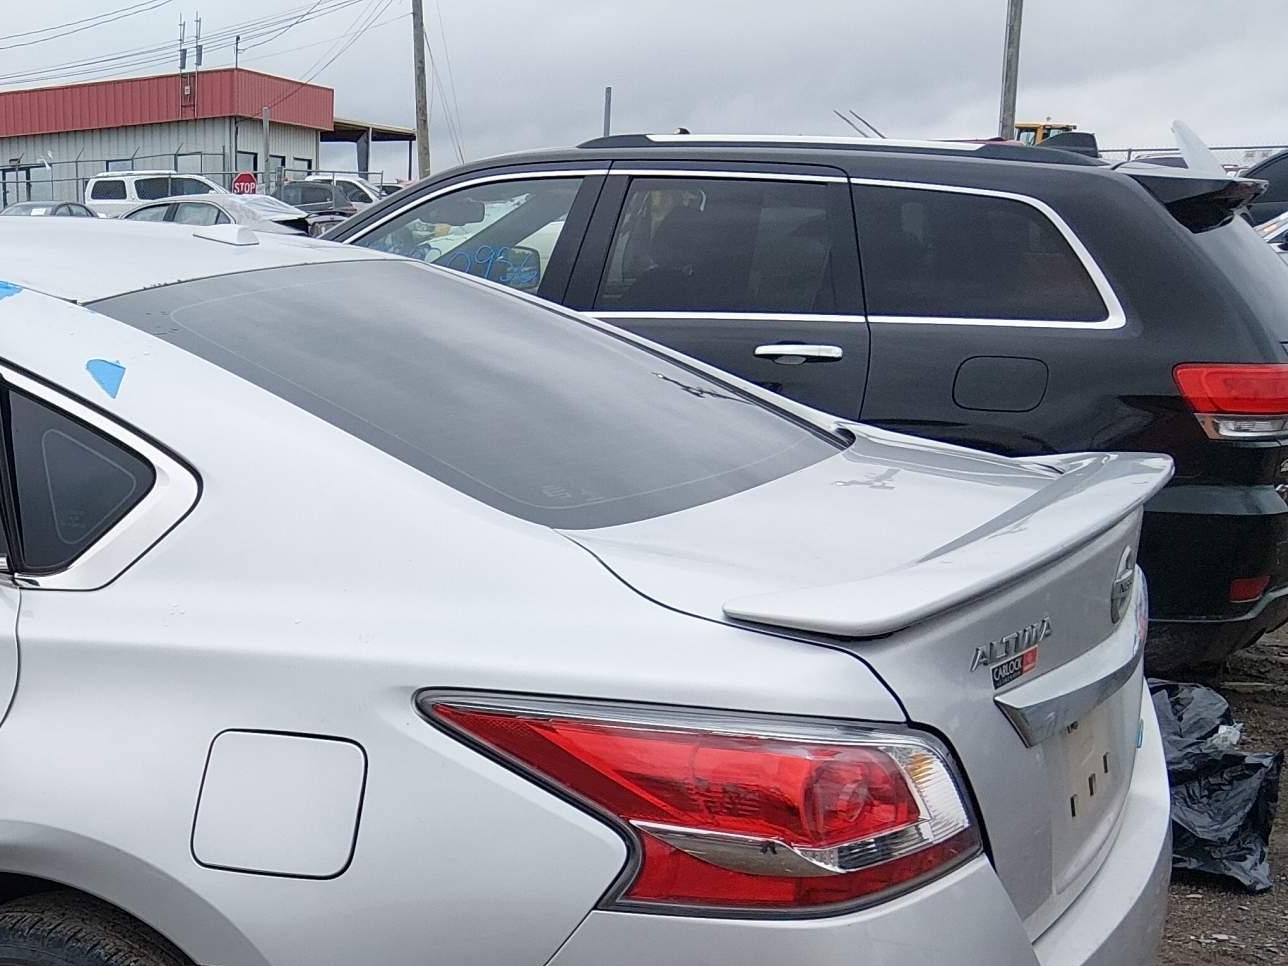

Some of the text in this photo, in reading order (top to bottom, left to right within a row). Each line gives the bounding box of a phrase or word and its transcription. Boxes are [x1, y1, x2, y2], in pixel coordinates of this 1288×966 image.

[234, 182, 256, 193] STOP
[968, 616, 1052, 672] ALTIMA
[992, 658, 1023, 681] CARLOCK
